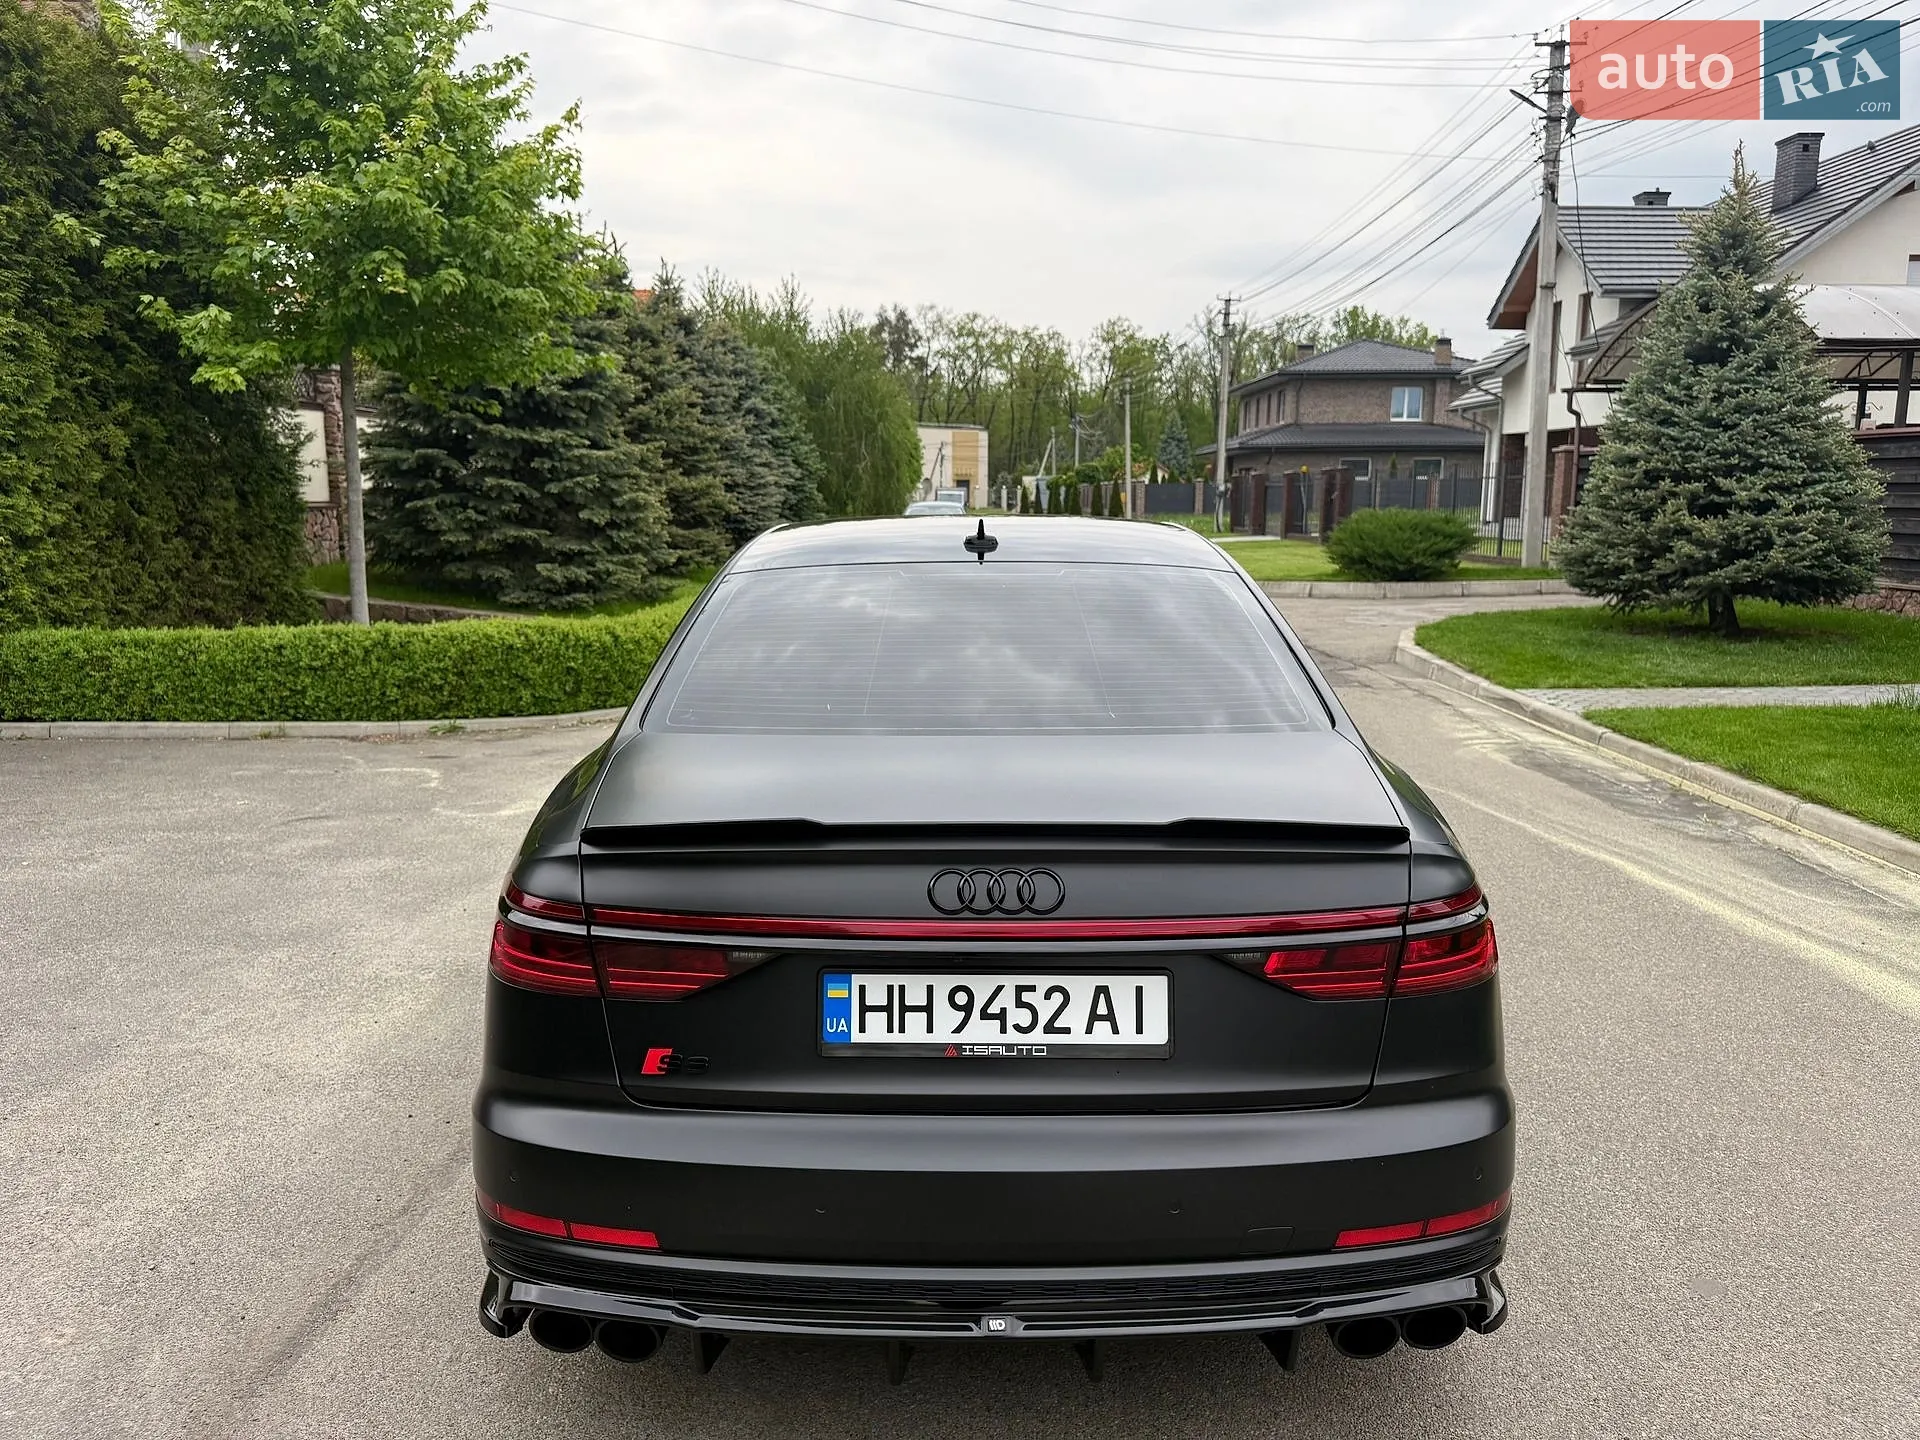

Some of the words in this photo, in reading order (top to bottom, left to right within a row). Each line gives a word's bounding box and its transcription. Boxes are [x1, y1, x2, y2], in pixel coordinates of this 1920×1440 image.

[857, 983, 934, 1034] HH
[947, 984, 1071, 1035] 9452
[1085, 984, 1144, 1035] AI
[826, 1018, 849, 1034] UA
[961, 1045, 1048, 1056] ISAUTO
